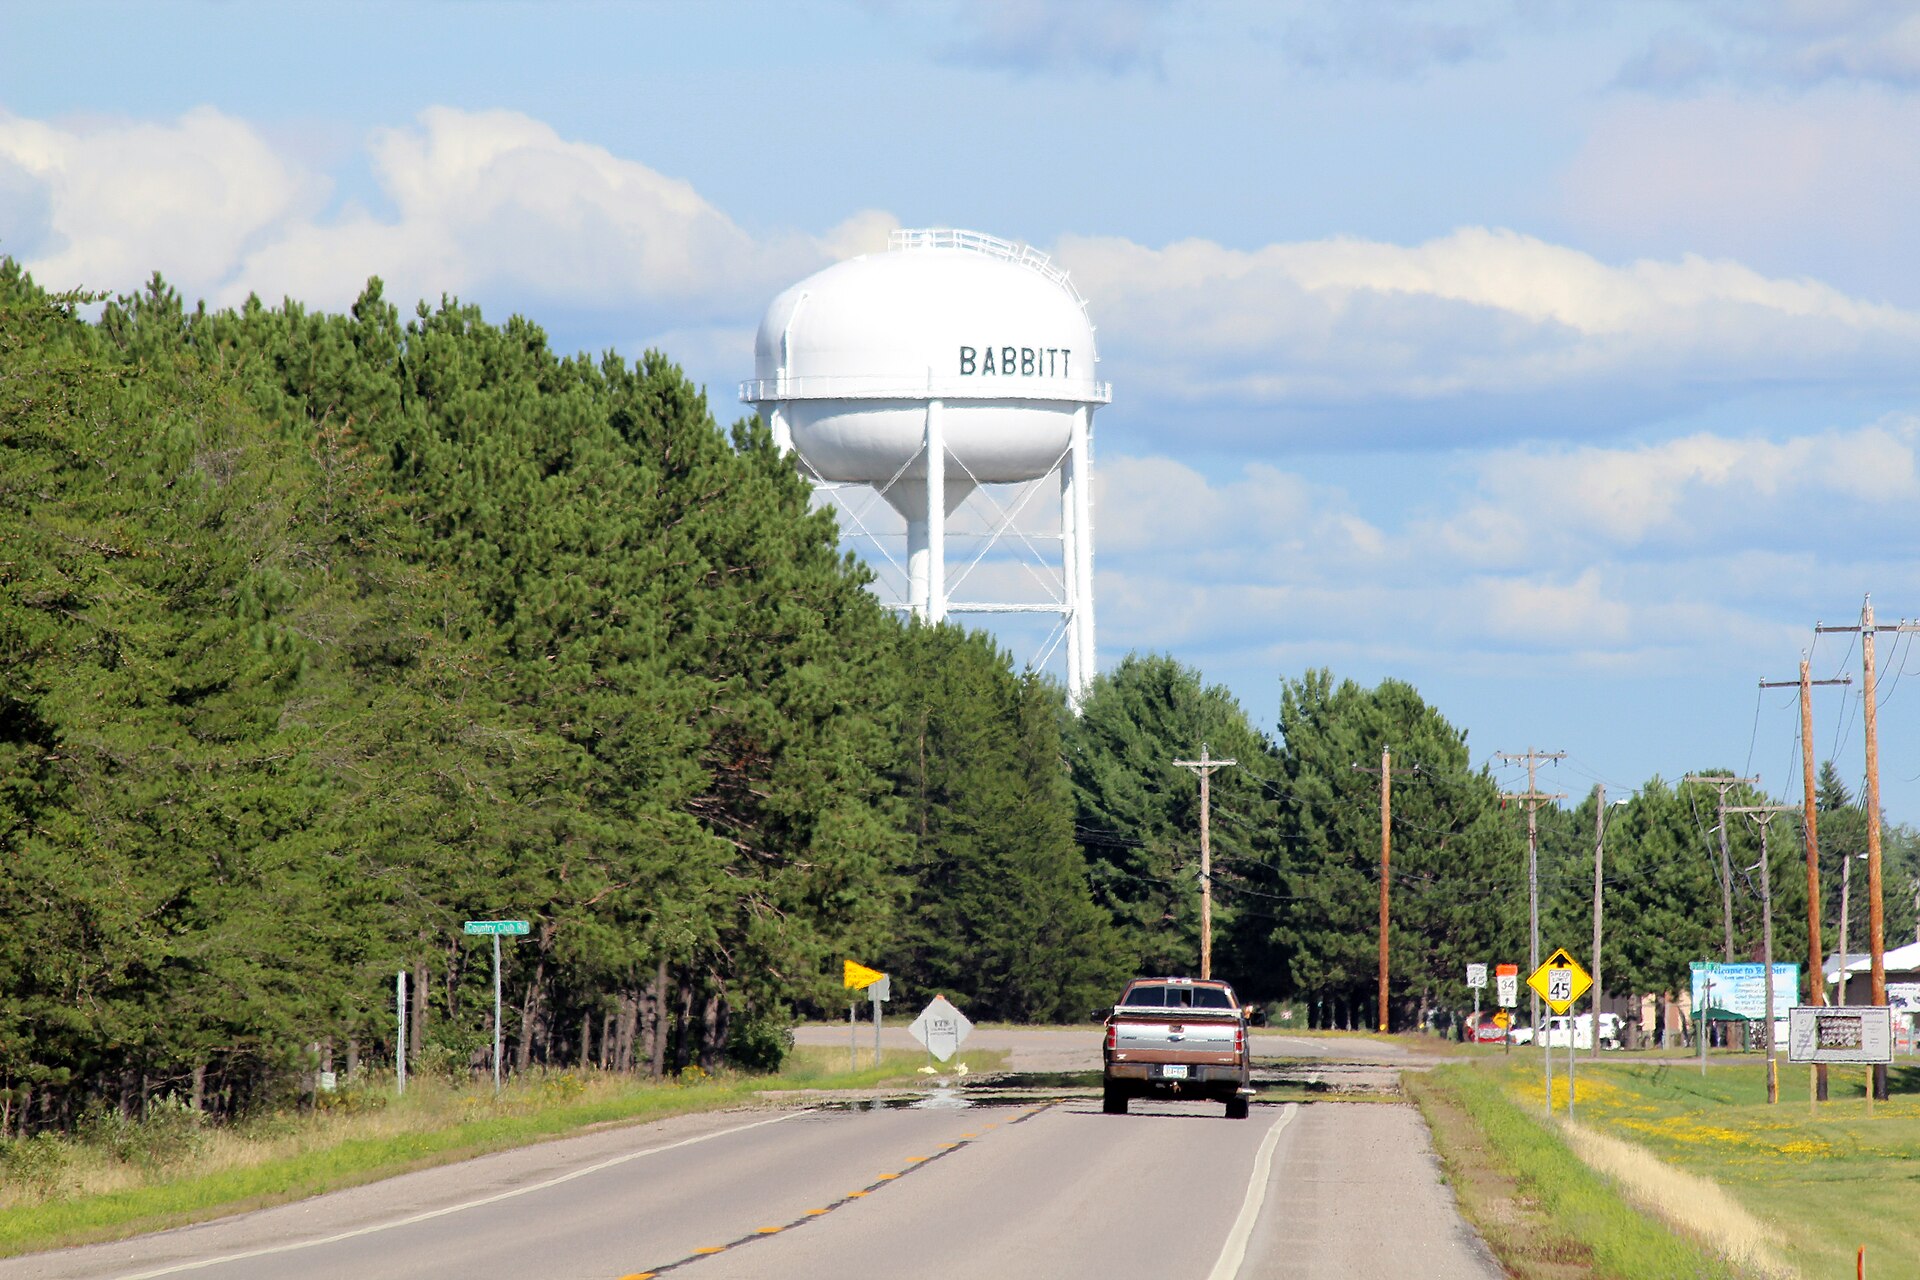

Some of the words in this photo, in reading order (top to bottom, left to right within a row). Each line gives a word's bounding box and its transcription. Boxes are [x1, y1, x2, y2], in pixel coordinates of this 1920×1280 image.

[959, 346, 1071, 378] BABBITT
[497, 923, 515, 933] Club
[1745, 965, 1753, 975] to
[1756, 965, 1787, 975] Babitt
[1470, 976, 1485, 986] 45
[1501, 980, 1515, 990] 34
[1550, 982, 1570, 1000] 45
